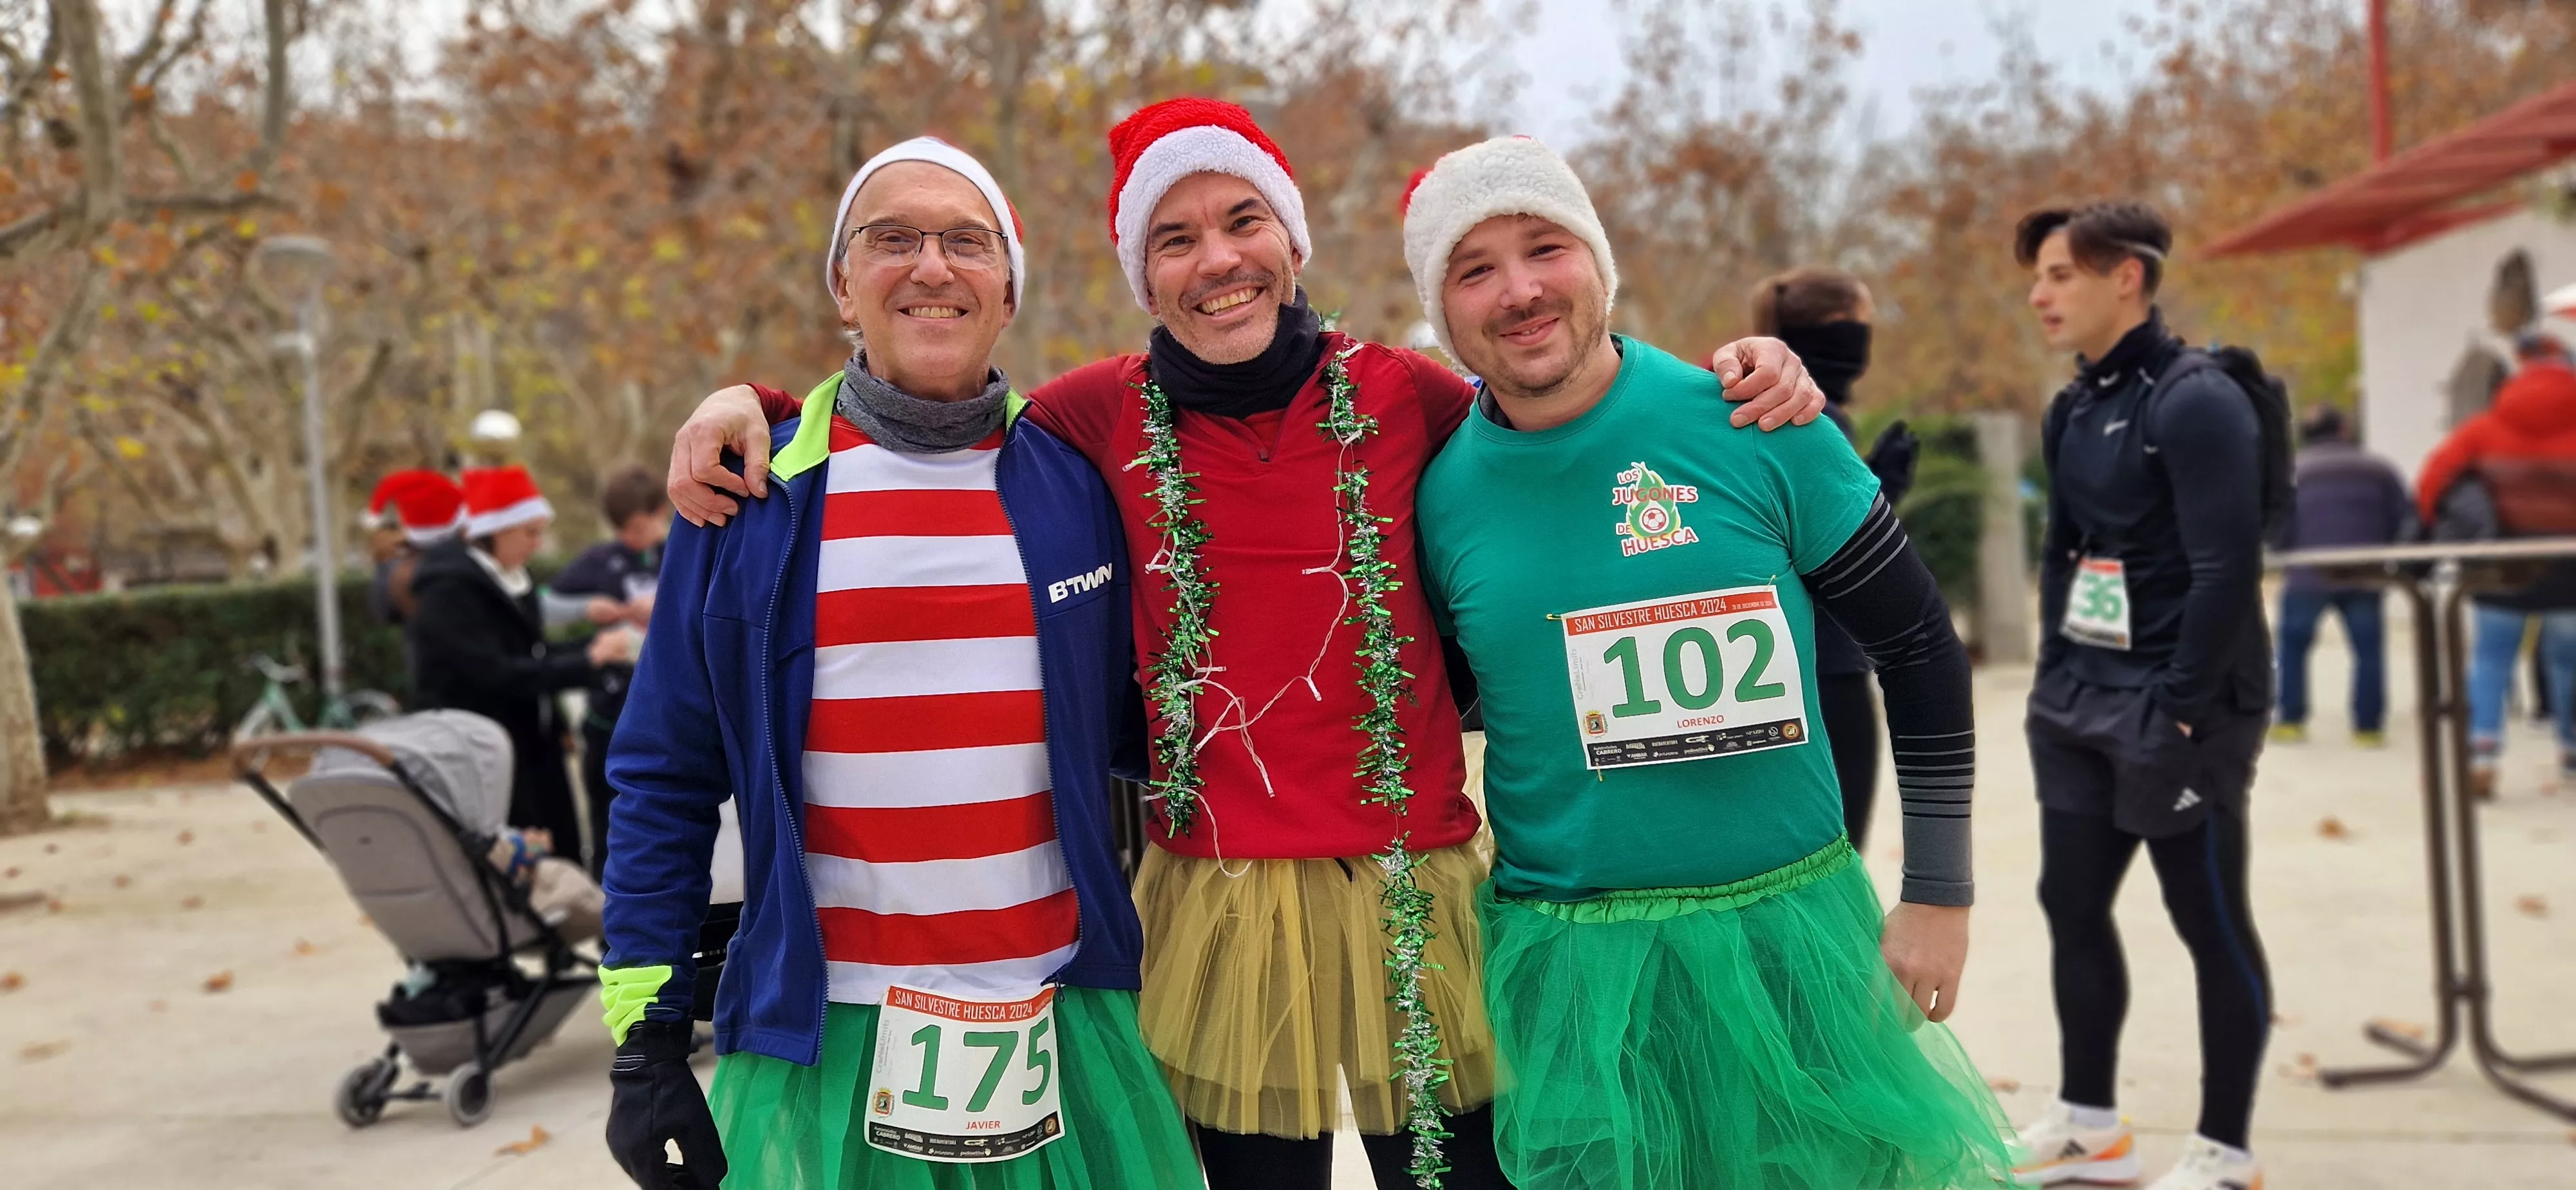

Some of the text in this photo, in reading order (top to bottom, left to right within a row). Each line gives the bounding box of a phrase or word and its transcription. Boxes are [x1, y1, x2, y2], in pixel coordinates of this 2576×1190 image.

[1619, 470, 1638, 483] LOS
[1613, 487, 1697, 505] JUGONES
[1618, 525, 1631, 534] DE
[1623, 529, 1696, 556] HUESCA
[1575, 616, 1596, 632] SAN
[1598, 609, 1653, 628] SILVESTRE
[1654, 603, 1698, 620] HUESCA
[1700, 598, 1727, 614] 2024
[1603, 618, 1786, 718] 102
[1677, 715, 1725, 729] LORENZO
[895, 990, 913, 1007] SAN
[914, 995, 961, 1017] SILVESTRE
[963, 1005, 1006, 1019] HUESCA
[1009, 1002, 1032, 1019] 2024
[902, 1016, 1052, 1112] 175
[966, 1120, 1001, 1130] JAVIER
